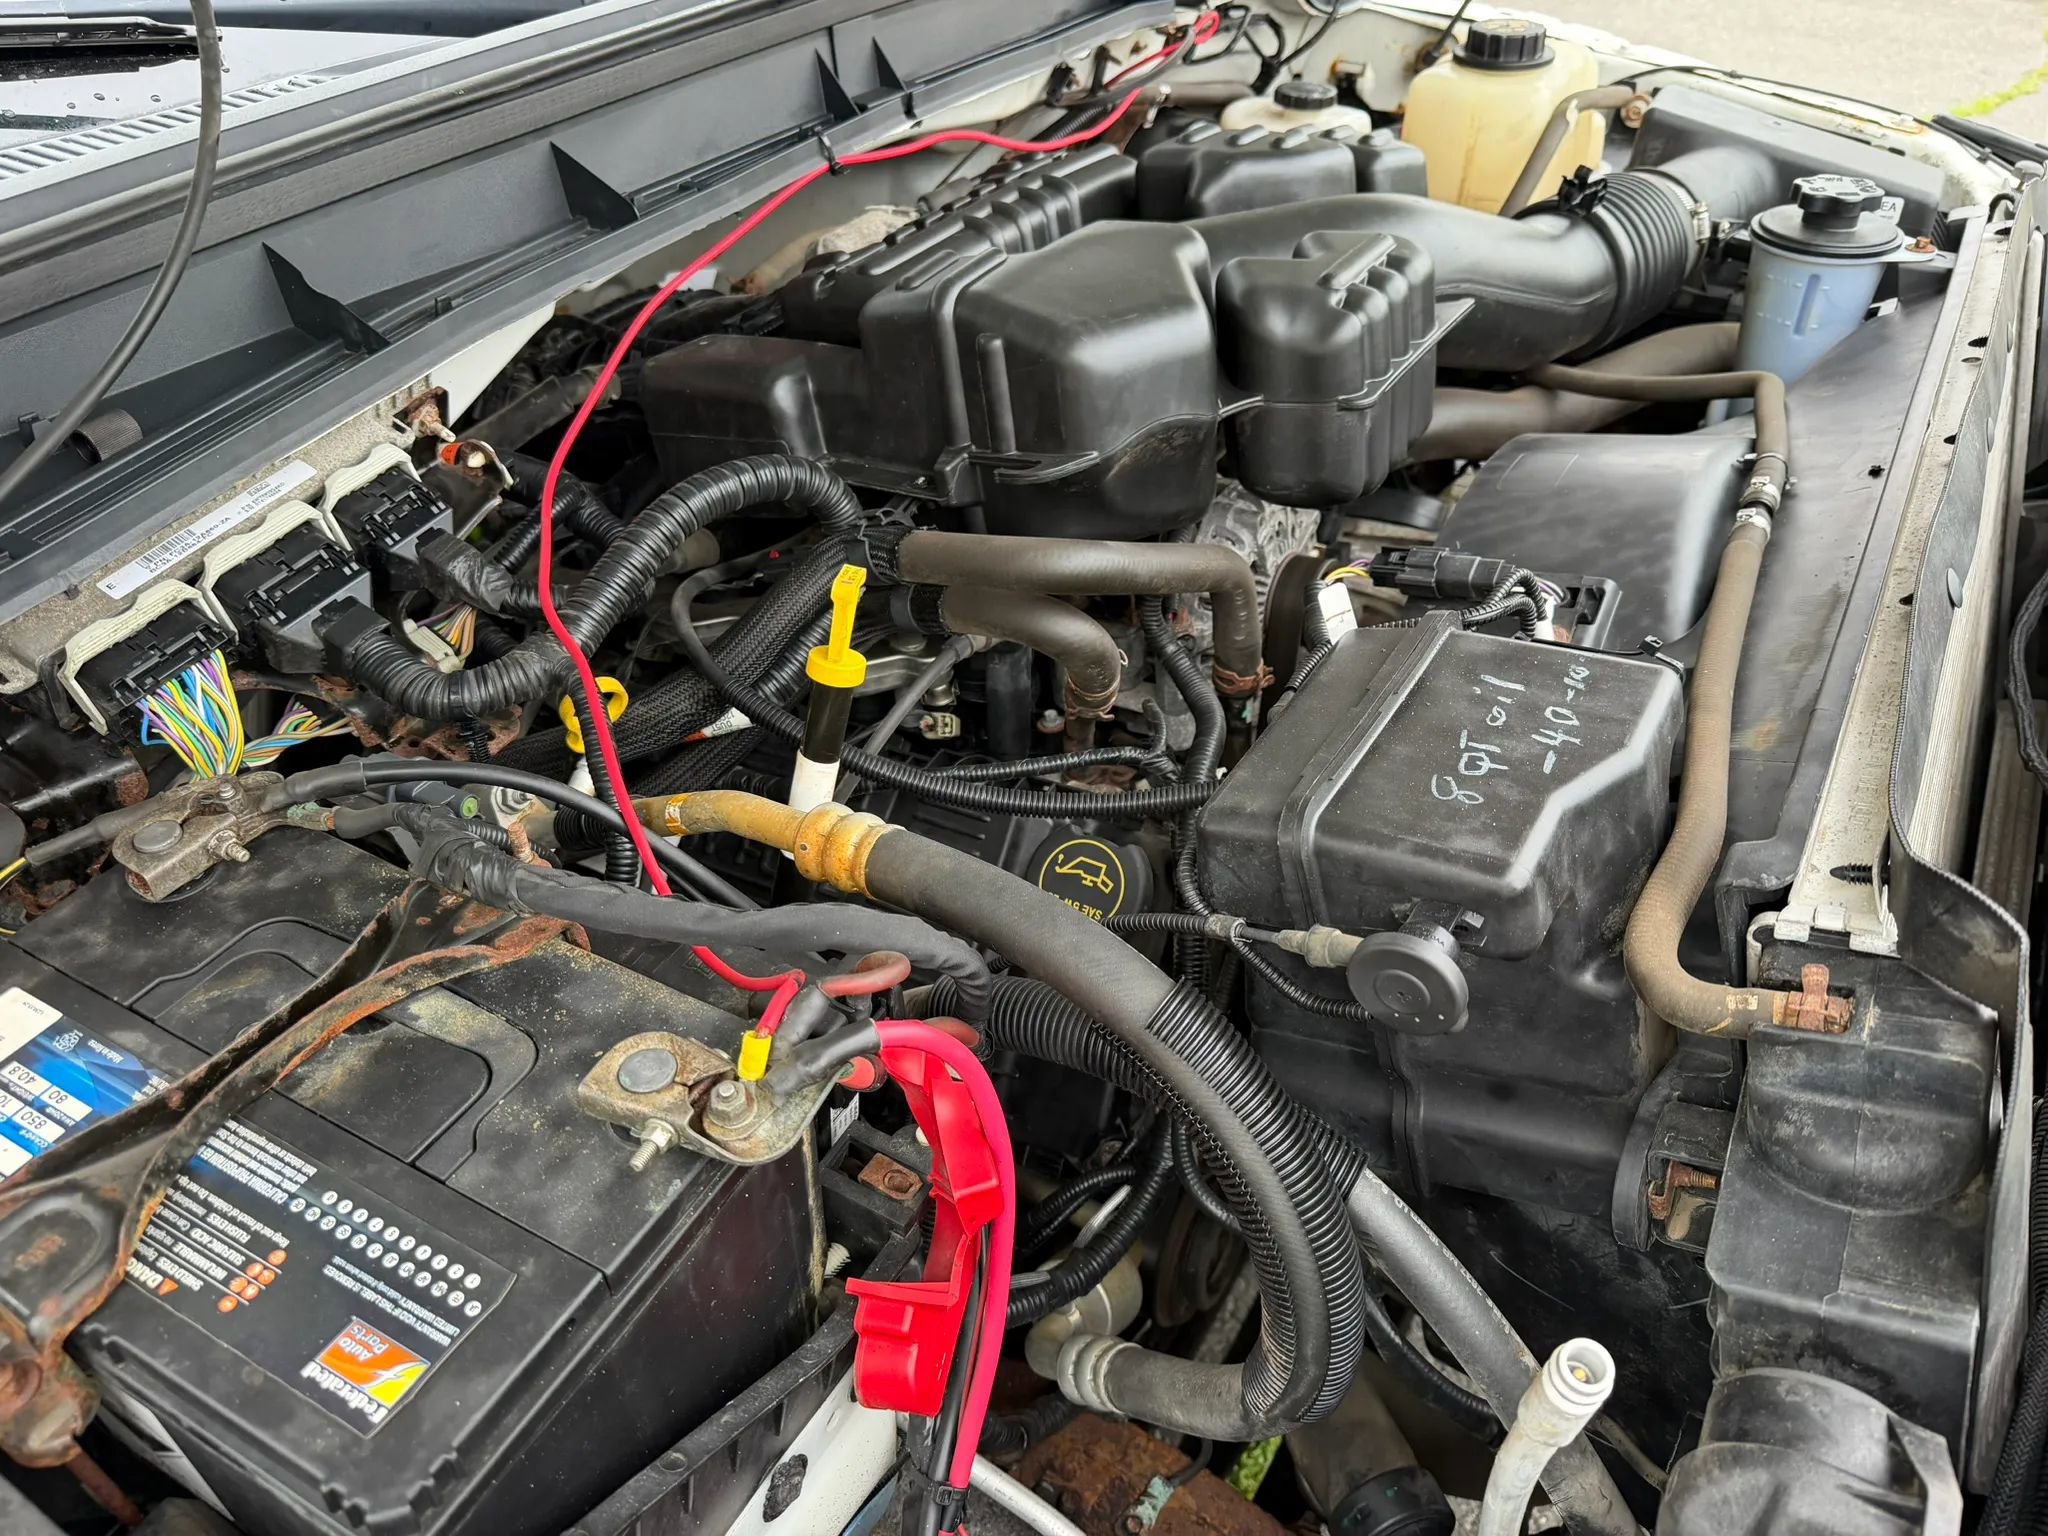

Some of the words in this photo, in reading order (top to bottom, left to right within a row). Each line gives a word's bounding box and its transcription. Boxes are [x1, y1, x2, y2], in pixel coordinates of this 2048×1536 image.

[1472, 674, 1527, 727] oil
[1081, 904, 1103, 920] SAE
[6, 1064, 38, 1086] 40.8
[47, 1089, 68, 1104] 80
[19, 1110, 47, 1129] 850
[208, 1152, 253, 1184] PROPOSITION
[247, 1175, 288, 1204] CALIFORNIA
[188, 1226, 213, 1246] ACID
[223, 1222, 250, 1243] FLUSH
[172, 1241, 227, 1280] INFLAMMABLE
[209, 1239, 245, 1266] SULFURIC
[155, 1256, 178, 1275] EYES
[175, 1268, 203, 1291] SHIELD
[339, 1336, 374, 1361] Auto
[349, 1325, 390, 1355] Parts
[299, 1360, 389, 1424] Federated
